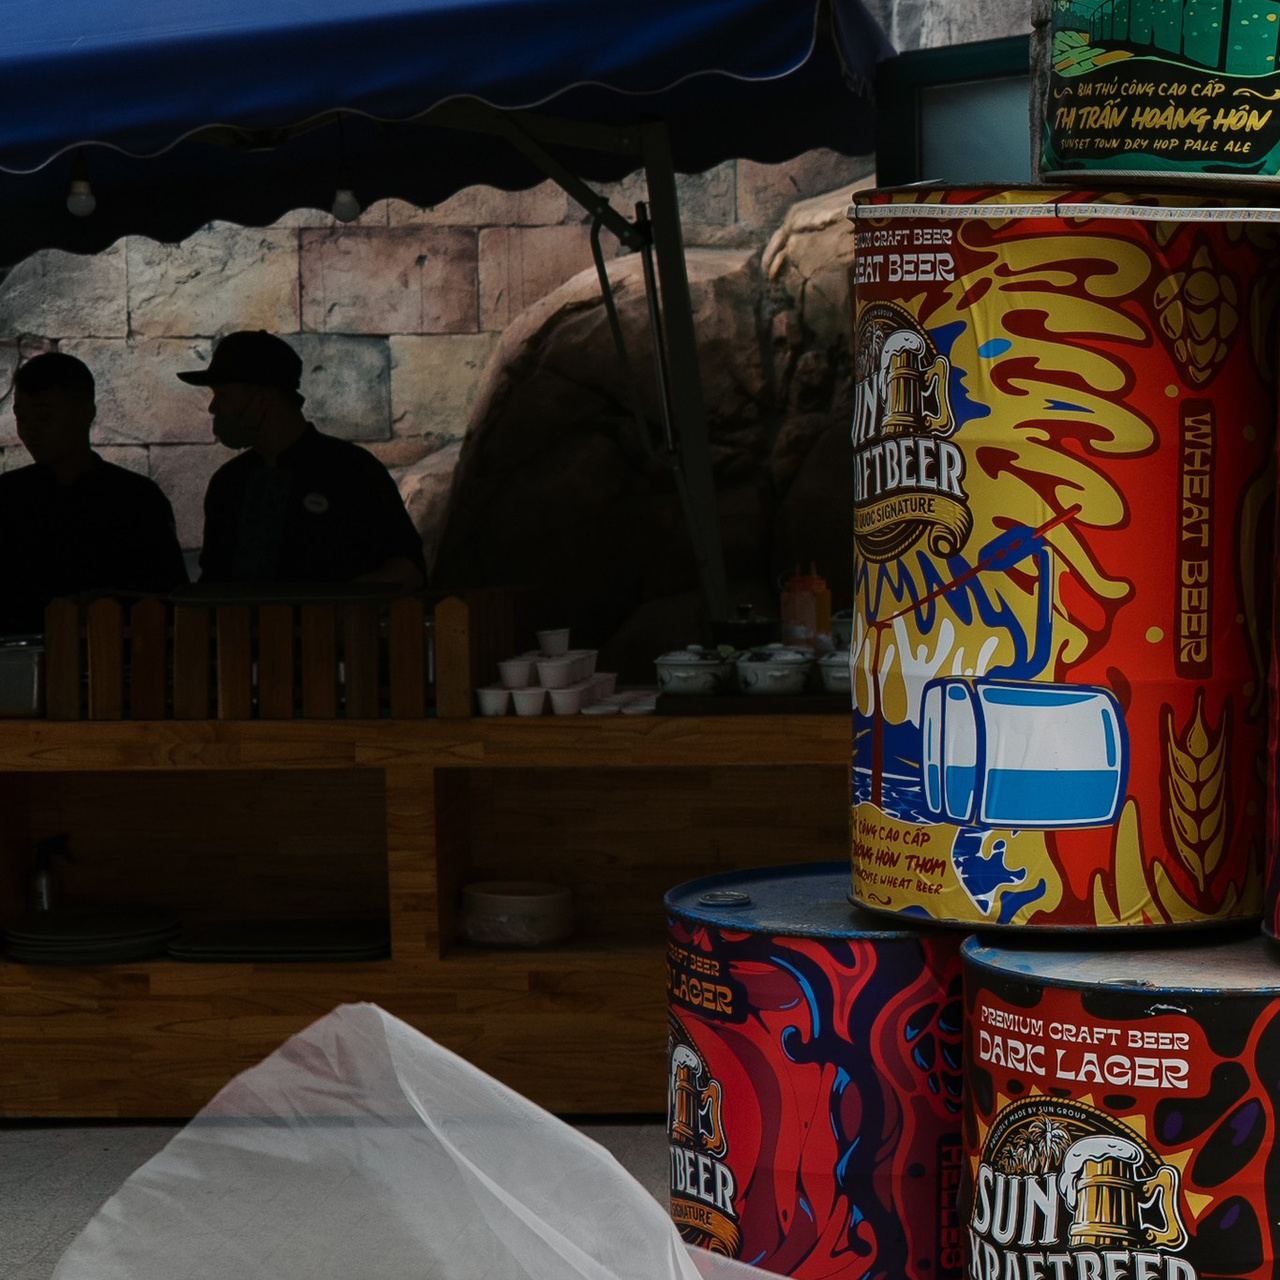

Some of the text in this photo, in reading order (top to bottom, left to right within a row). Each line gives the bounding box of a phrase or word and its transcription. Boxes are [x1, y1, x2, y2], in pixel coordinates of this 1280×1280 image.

[1077, 76, 1225, 98] BIA THỦ CÔNG CAO CẤP
[1054, 98, 1273, 134] THỊ TRẤN HOÀNG HÔN
[1061, 137, 1252, 153] SUNSET TOWN DRY HOP PALE ALE
[874, 229, 953, 247] CRAFT BEER
[888, 252, 955, 282] BEER
[876, 497, 935, 522] SIGNATURE
[1180, 412, 1212, 663] WHEAT BEER
[879, 826, 900, 842] CAO
[903, 827, 931, 847] CẤP
[875, 846, 947, 877] HÒN THƠM
[880, 874, 943, 895] WHEAT BEER
[673, 968, 733, 1015] LAGER
[981, 1005, 1190, 1051] PREMIUM CRAFT BEER
[979, 1029, 1190, 1089] DARK LAGER
[989, 1106, 1087, 1149] PROUDLY MADE BY SUN GROUP
[972, 1162, 1060, 1247] SUN
